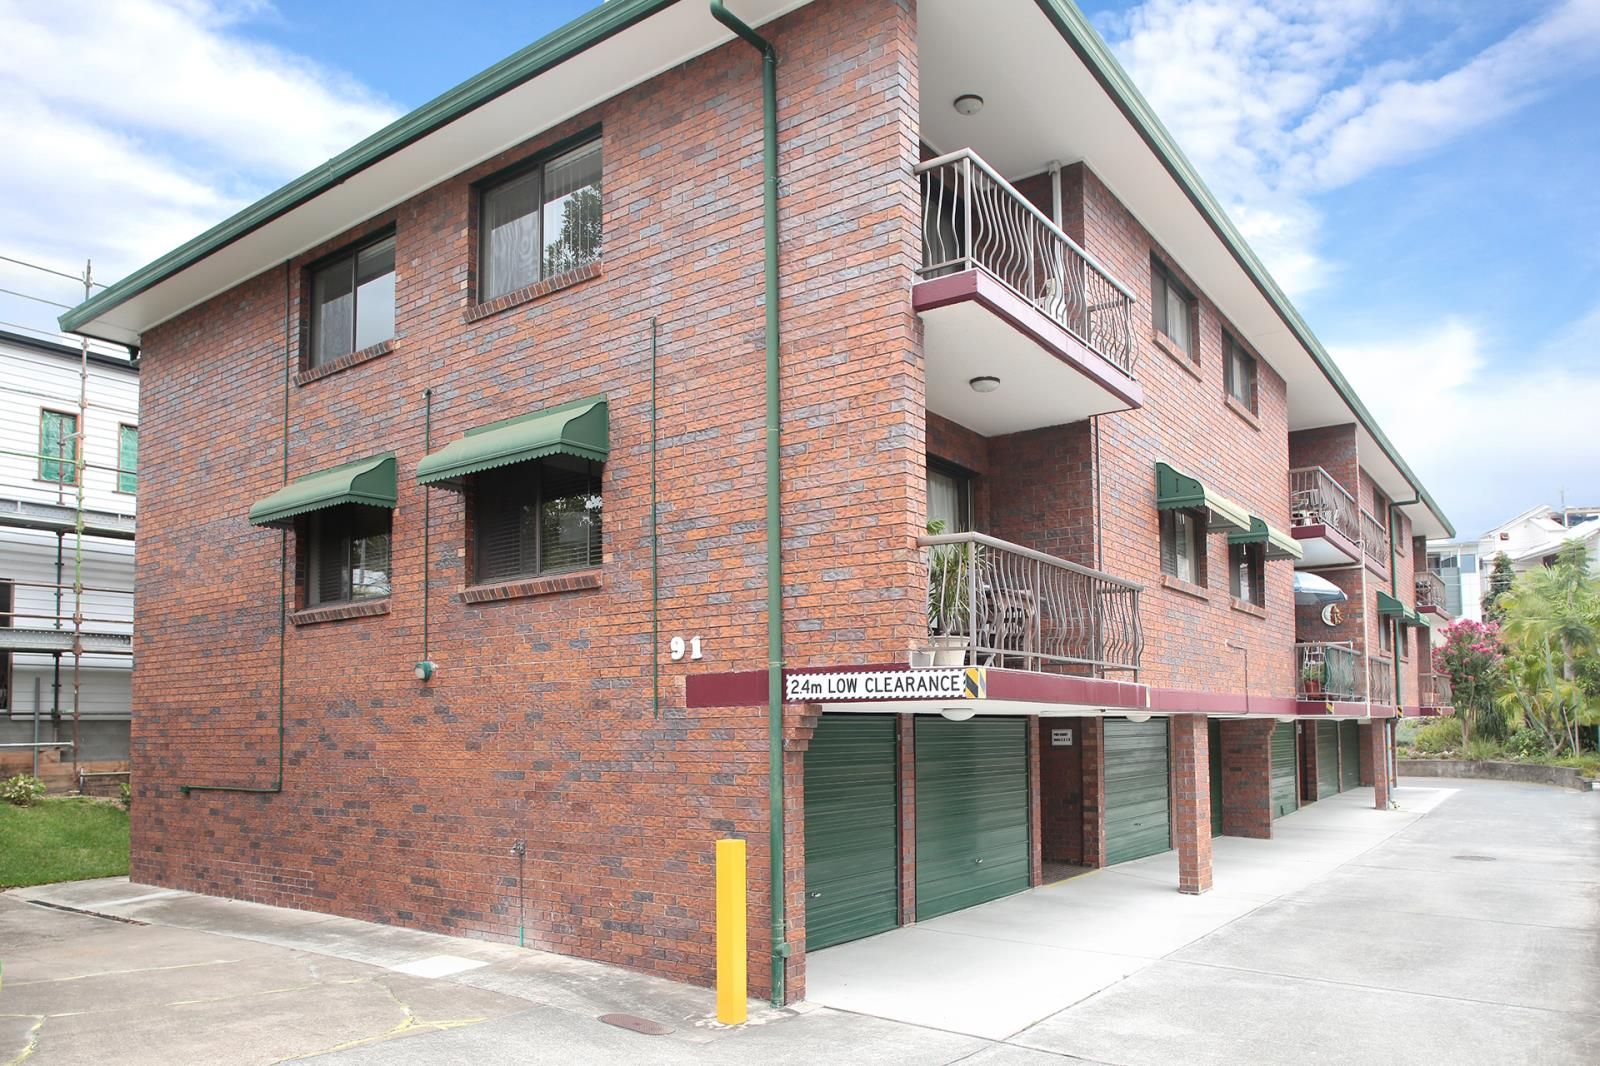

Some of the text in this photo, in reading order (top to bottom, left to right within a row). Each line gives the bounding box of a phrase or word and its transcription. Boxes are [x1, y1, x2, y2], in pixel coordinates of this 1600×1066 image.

[670, 635, 703, 660] 91
[828, 678, 858, 694] LOW
[865, 675, 960, 692] CLEARANCE
